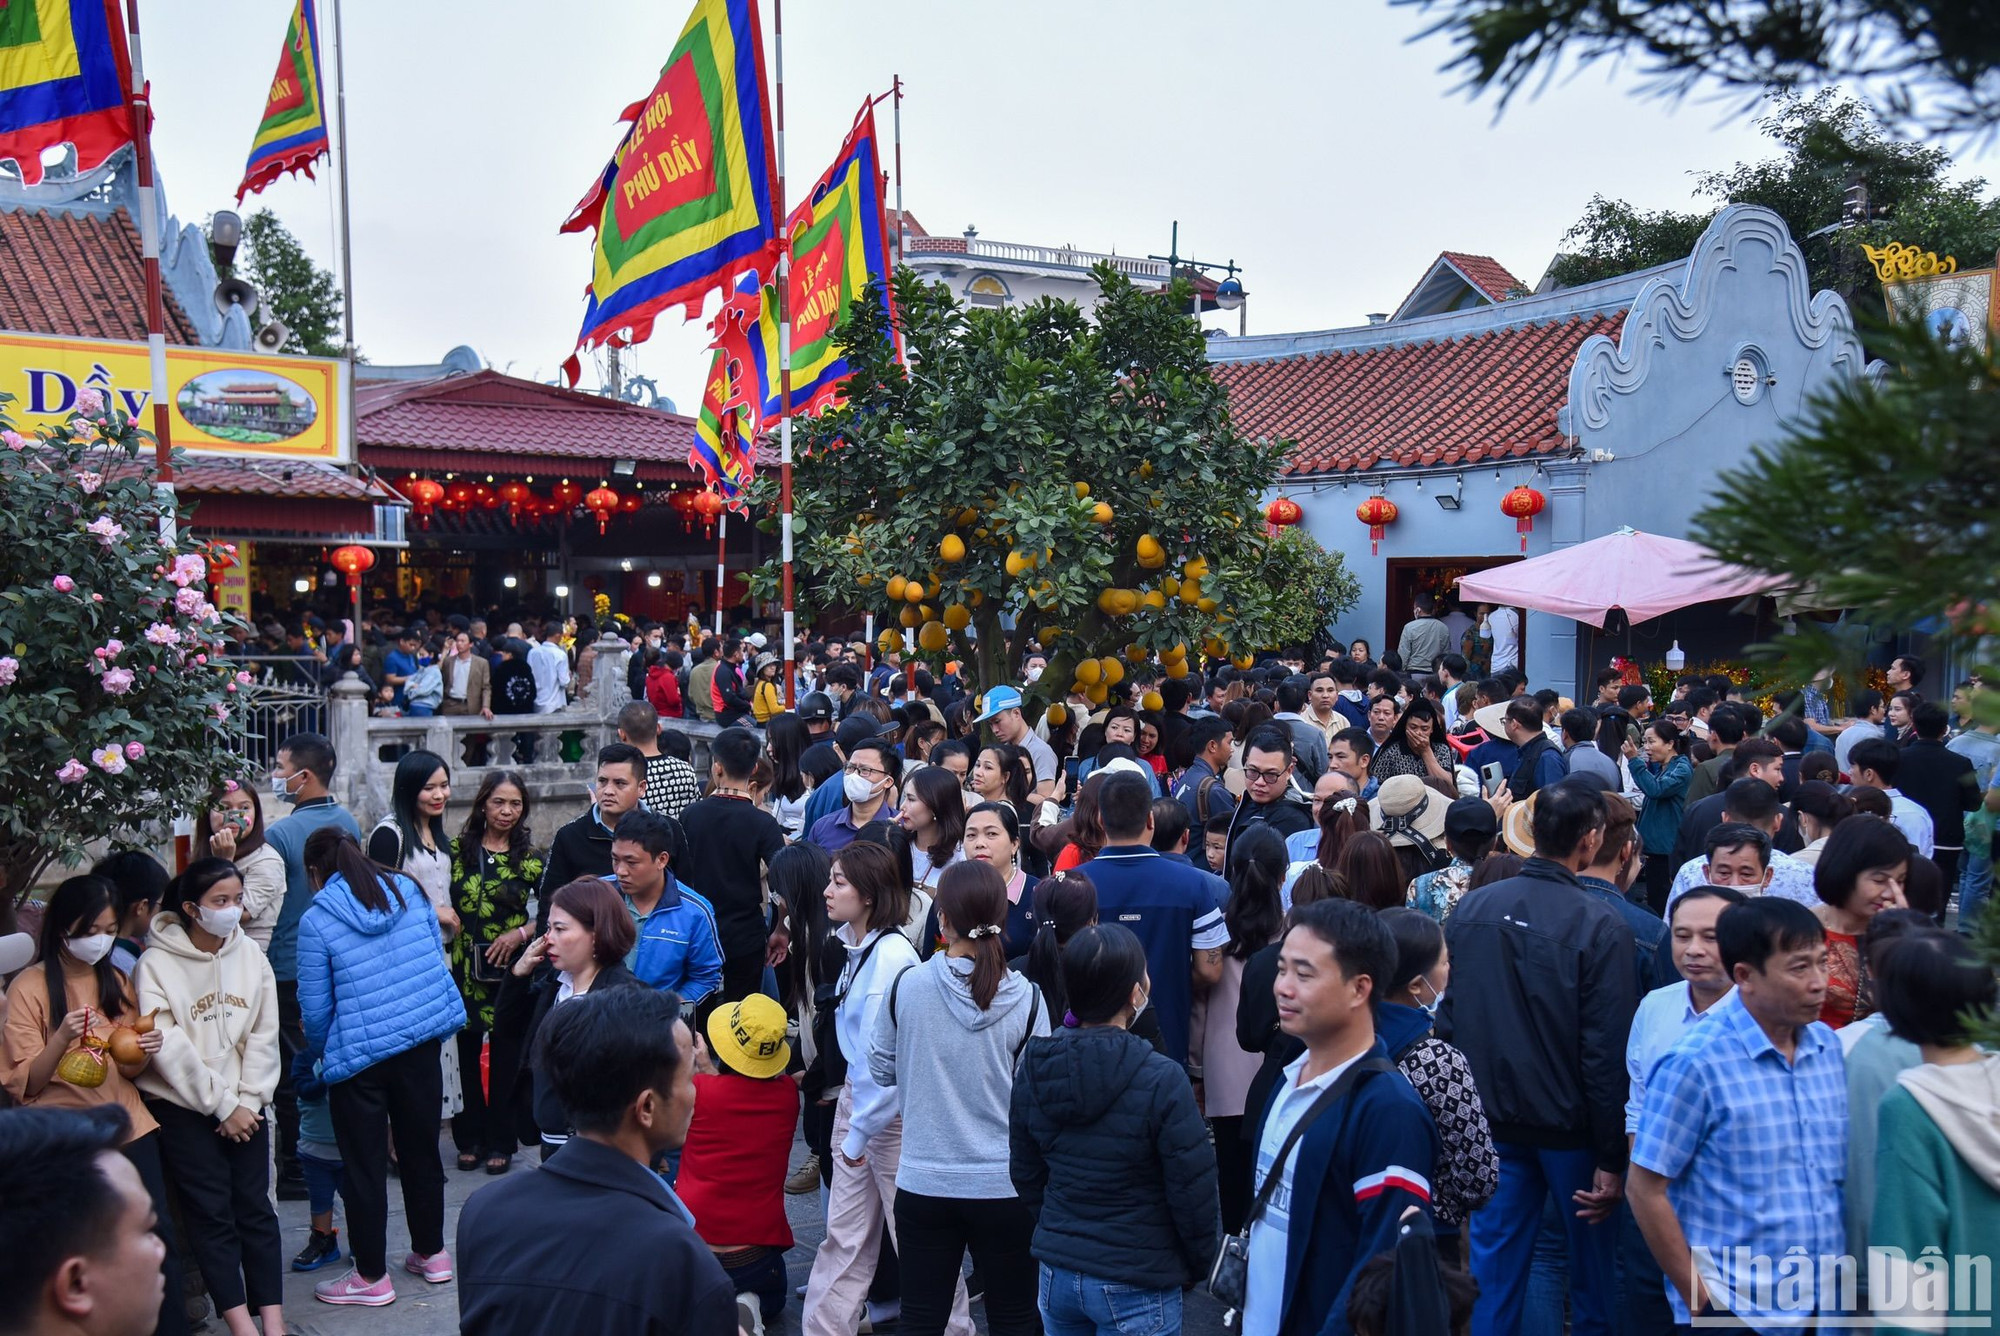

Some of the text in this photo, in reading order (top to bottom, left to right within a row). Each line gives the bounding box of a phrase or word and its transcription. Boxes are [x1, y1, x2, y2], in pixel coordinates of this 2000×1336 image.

[645, 91, 673, 129] HỘI
[623, 134, 702, 210] PHỦ DẦY
